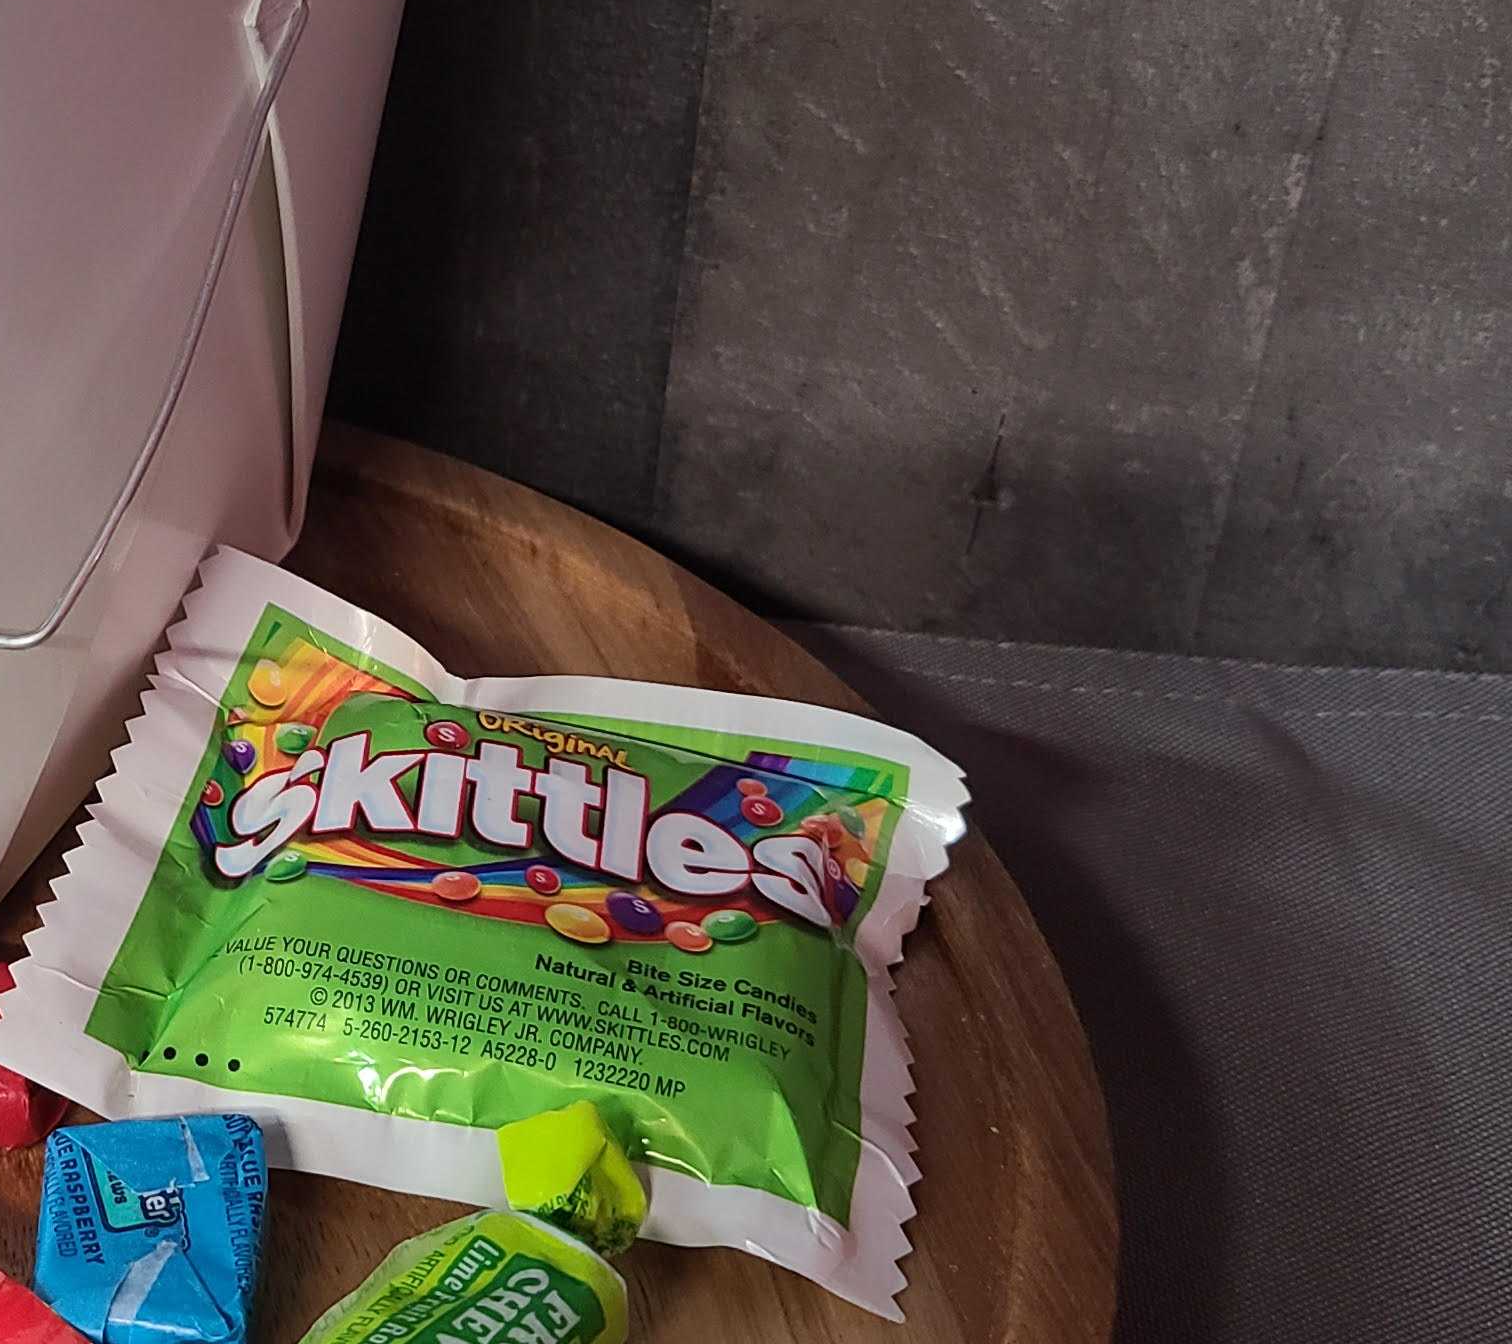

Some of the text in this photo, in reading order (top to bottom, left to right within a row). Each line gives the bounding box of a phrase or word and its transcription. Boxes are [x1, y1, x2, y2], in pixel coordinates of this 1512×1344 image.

[225, 936, 791, 1061] VALUE YOUR QUESTIONS OR COMMENTS. CALL 1-800-WRIGLEY
[238, 955, 730, 1063] (1-800-974-4539) OR VISIT US AT WWW.SKITTLES.COM
[331, 989, 375, 1014] 2013
[380, 997, 419, 1021] WM.
[425, 1004, 510, 1040] WRIGLEY
[513, 1021, 543, 1044] JR.
[548, 1028, 644, 1066] COMPANY.
[535, 953, 817, 1048] Natural & Artificial Flavors
[627, 958, 818, 1026] Bite Size Candies
[263, 1005, 686, 1099] 574774 5-260-2153-12 A5228-0 1232220 MP
[59, 1157, 106, 1265] RASPBERRY
[443, 1239, 501, 1292] Lime
